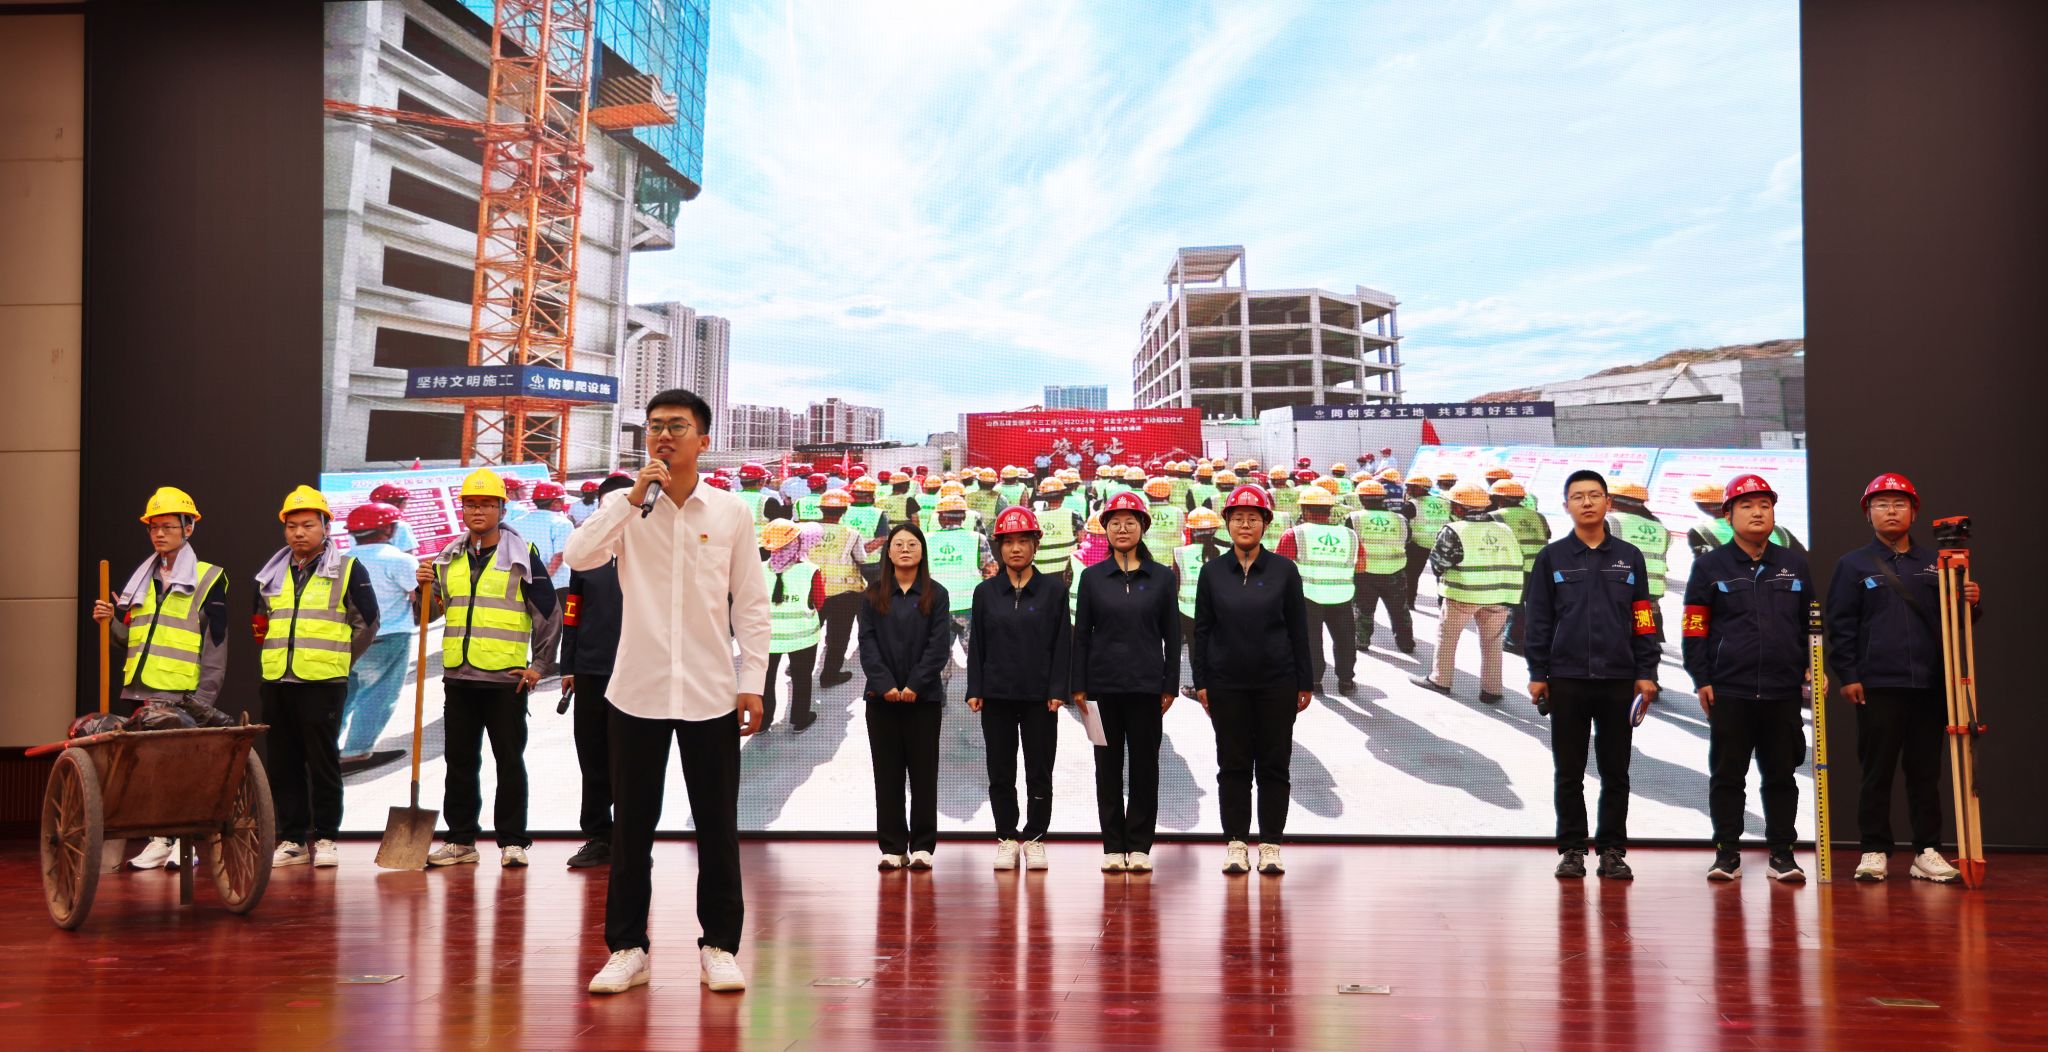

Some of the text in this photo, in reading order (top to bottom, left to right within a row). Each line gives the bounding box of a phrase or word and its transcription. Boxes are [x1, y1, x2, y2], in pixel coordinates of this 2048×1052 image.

[416, 374, 515, 389] 坚持文明施工
[547, 377, 611, 395] 防攀爬设施
[1330, 405, 1535, 419] 同创安全工地 共享美好生活
[564, 601, 577, 618] 工
